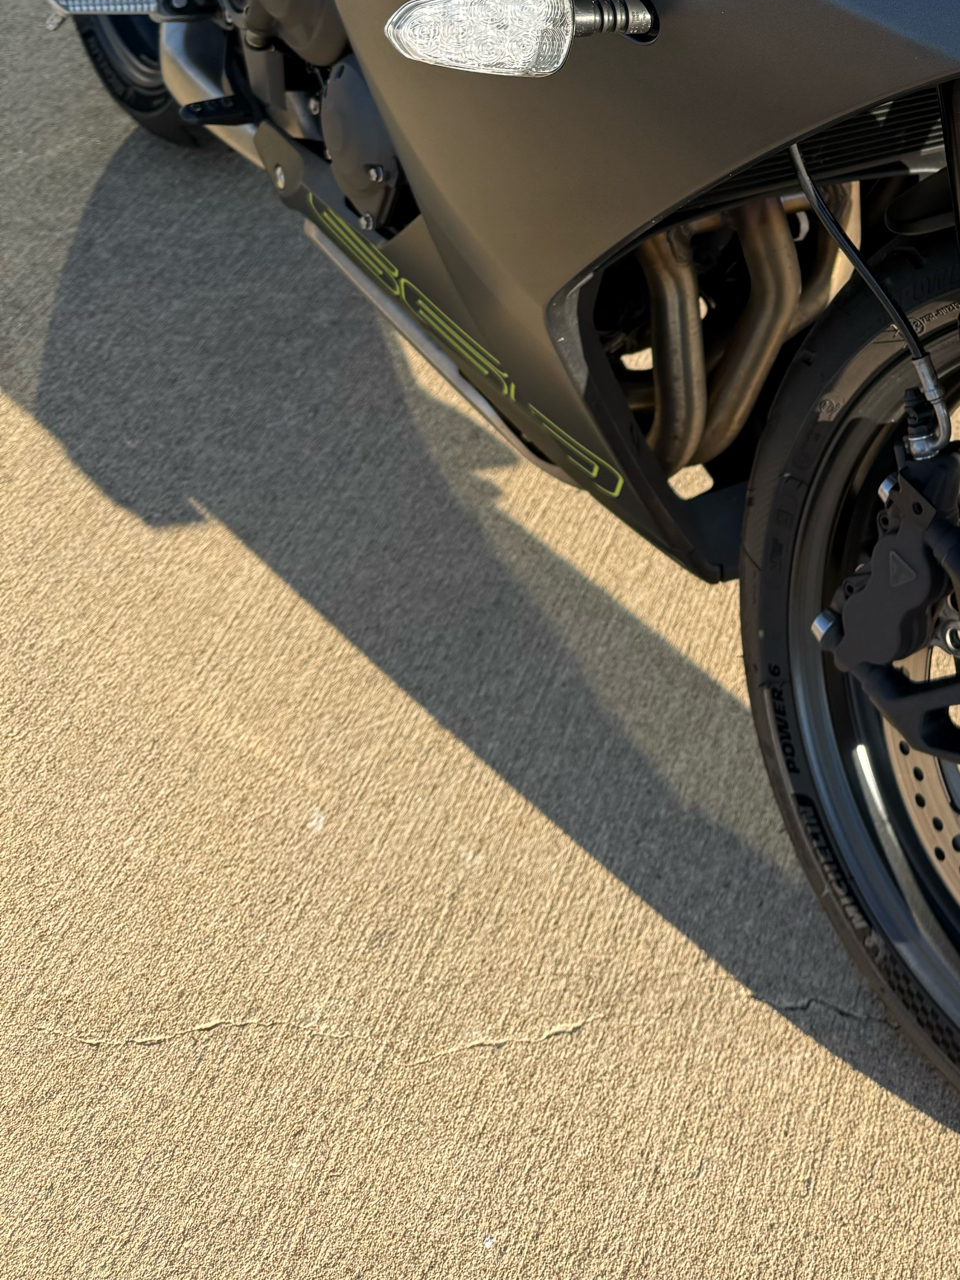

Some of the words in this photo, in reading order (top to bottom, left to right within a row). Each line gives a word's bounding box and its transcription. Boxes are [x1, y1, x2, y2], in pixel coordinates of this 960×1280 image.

[769, 663, 781, 677] 6
[771, 685, 800, 774] POWER
[801, 805, 868, 929] MICHELIN
